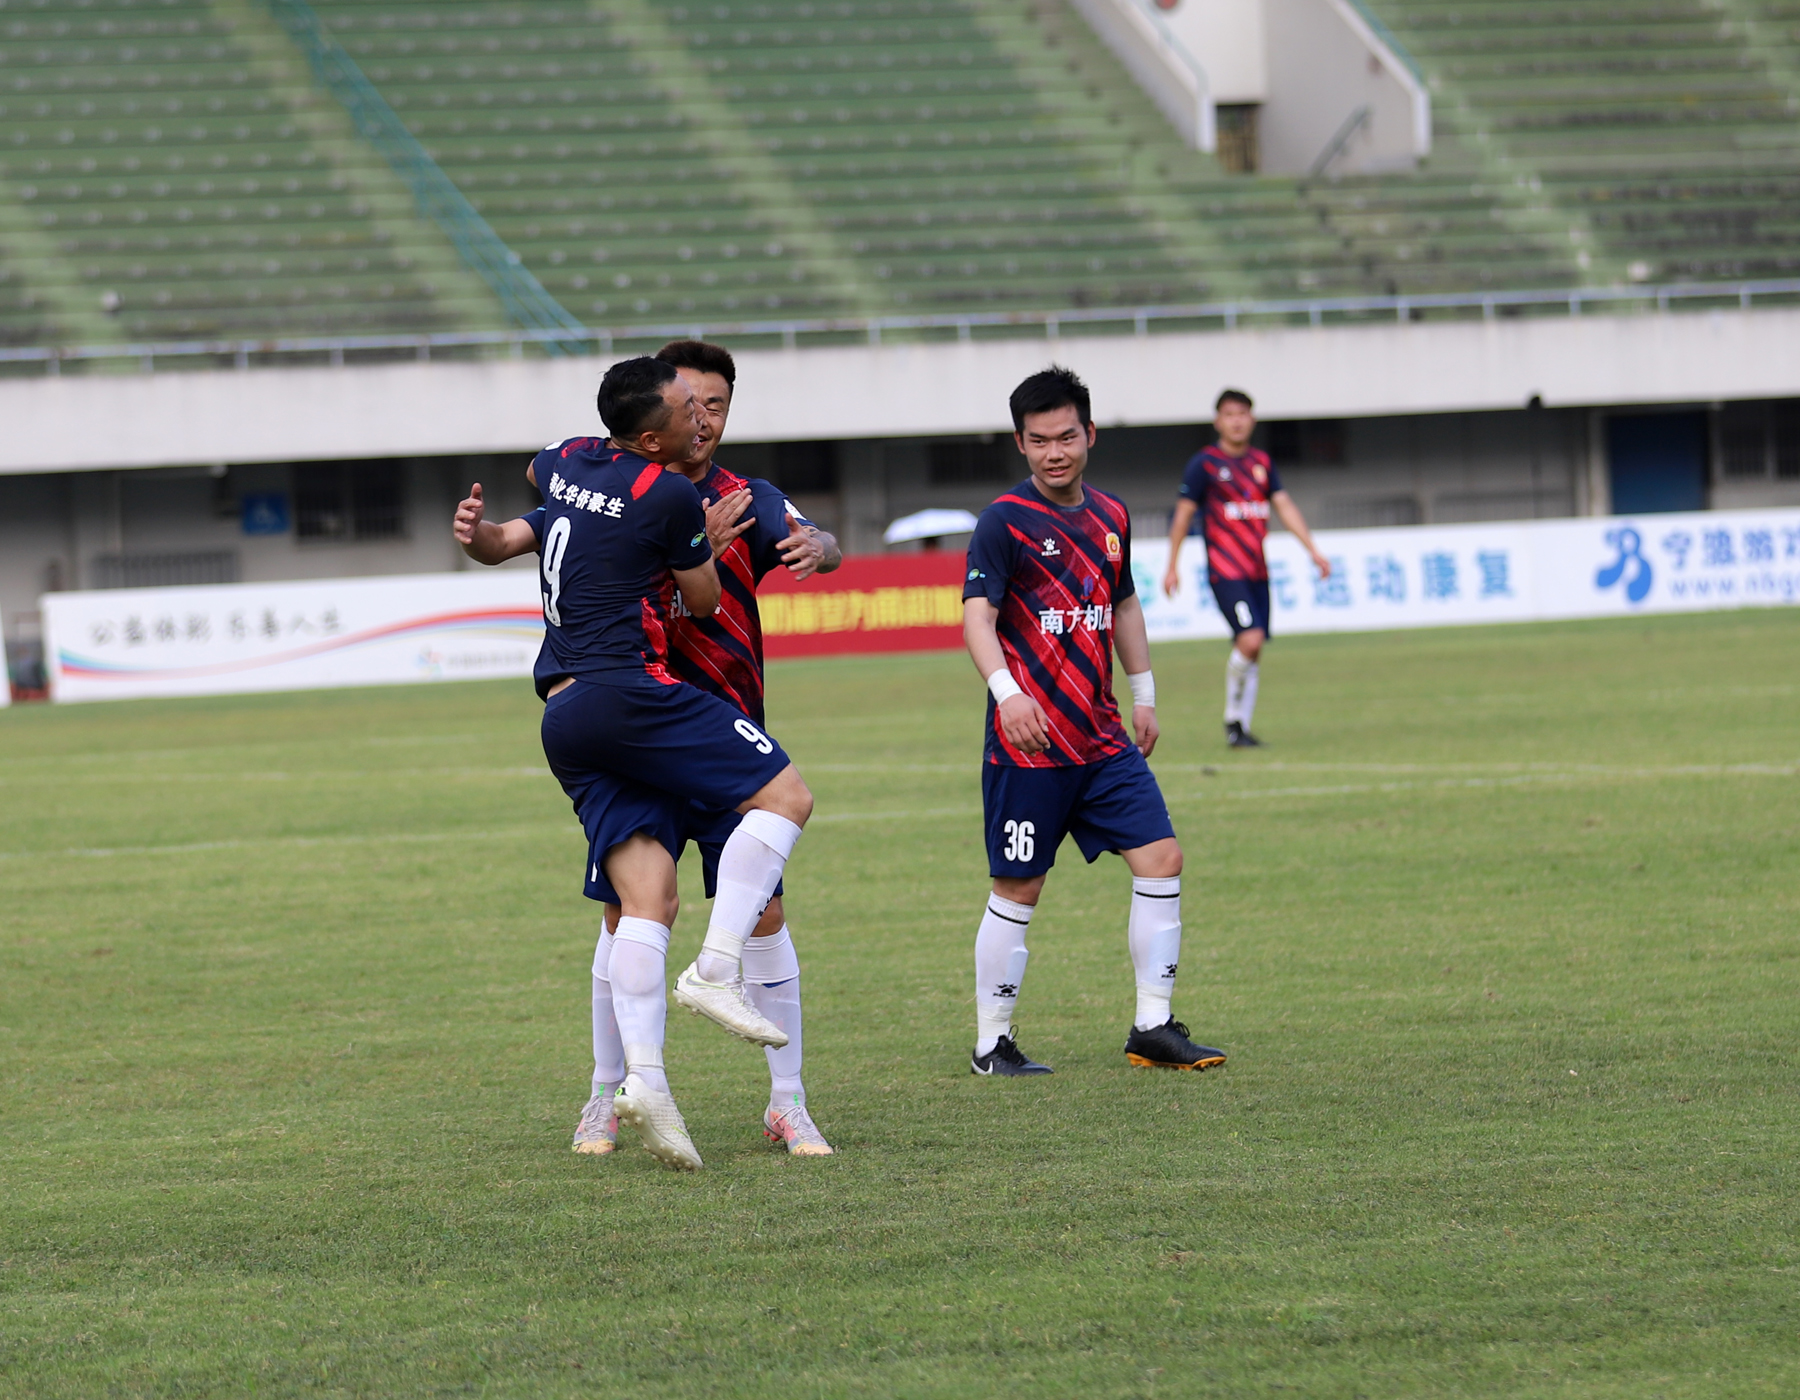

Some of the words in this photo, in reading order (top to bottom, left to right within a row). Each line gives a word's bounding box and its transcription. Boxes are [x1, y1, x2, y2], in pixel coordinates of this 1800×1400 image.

[542, 516, 572, 628] 9
[734, 718, 773, 755] 9
[1003, 819, 1035, 863] 36
